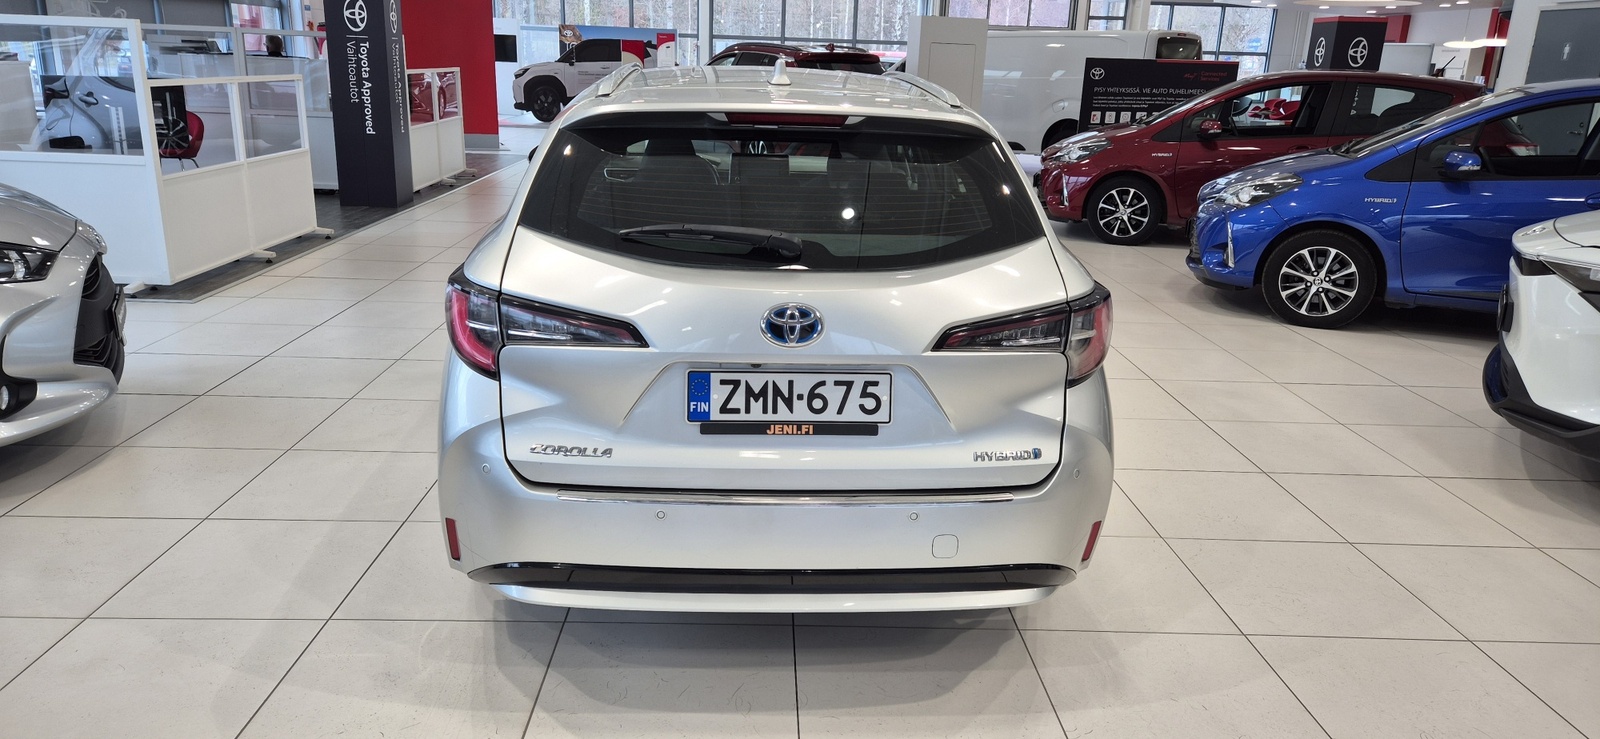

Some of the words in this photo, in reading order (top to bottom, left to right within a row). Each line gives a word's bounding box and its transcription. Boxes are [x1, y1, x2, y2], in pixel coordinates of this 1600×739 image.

[359, 41, 371, 79] Toyota
[346, 41, 359, 103] Vaihtoautot
[361, 80, 376, 134] Approved
[690, 402, 709, 413] FIN
[766, 424, 814, 435] JENI.FI
[529, 443, 614, 458] COROLLA
[973, 450, 1032, 462] HYBRID
